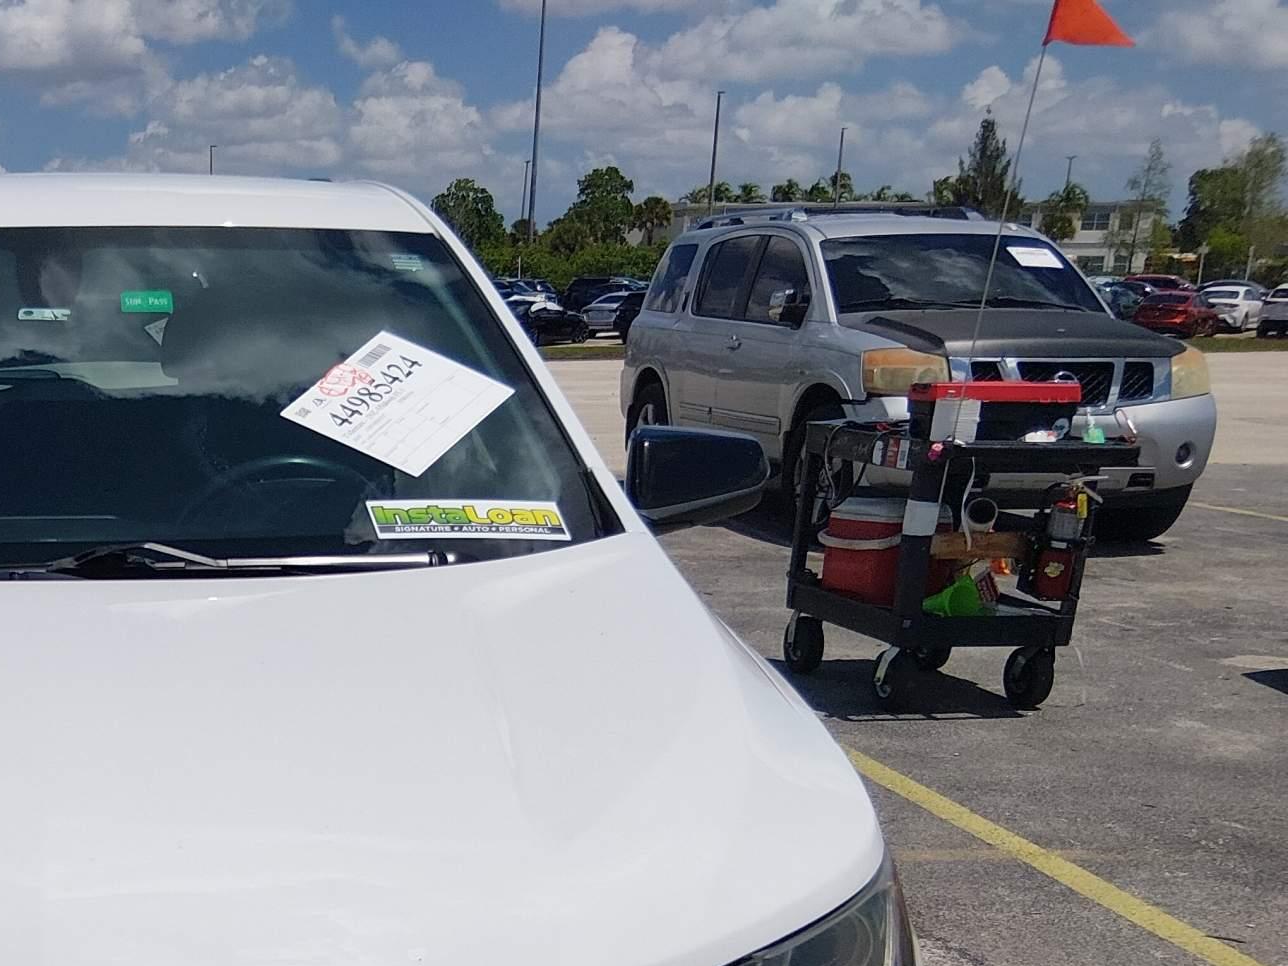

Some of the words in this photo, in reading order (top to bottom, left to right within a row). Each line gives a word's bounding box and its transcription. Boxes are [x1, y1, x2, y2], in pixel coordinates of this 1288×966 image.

[328, 355, 423, 428] 44985424
[370, 505, 563, 527] InstaLoan
[394, 525, 452, 533] SIGNATURE
[461, 525, 490, 533] AUTO
[498, 526, 552, 534] PERSONAL
